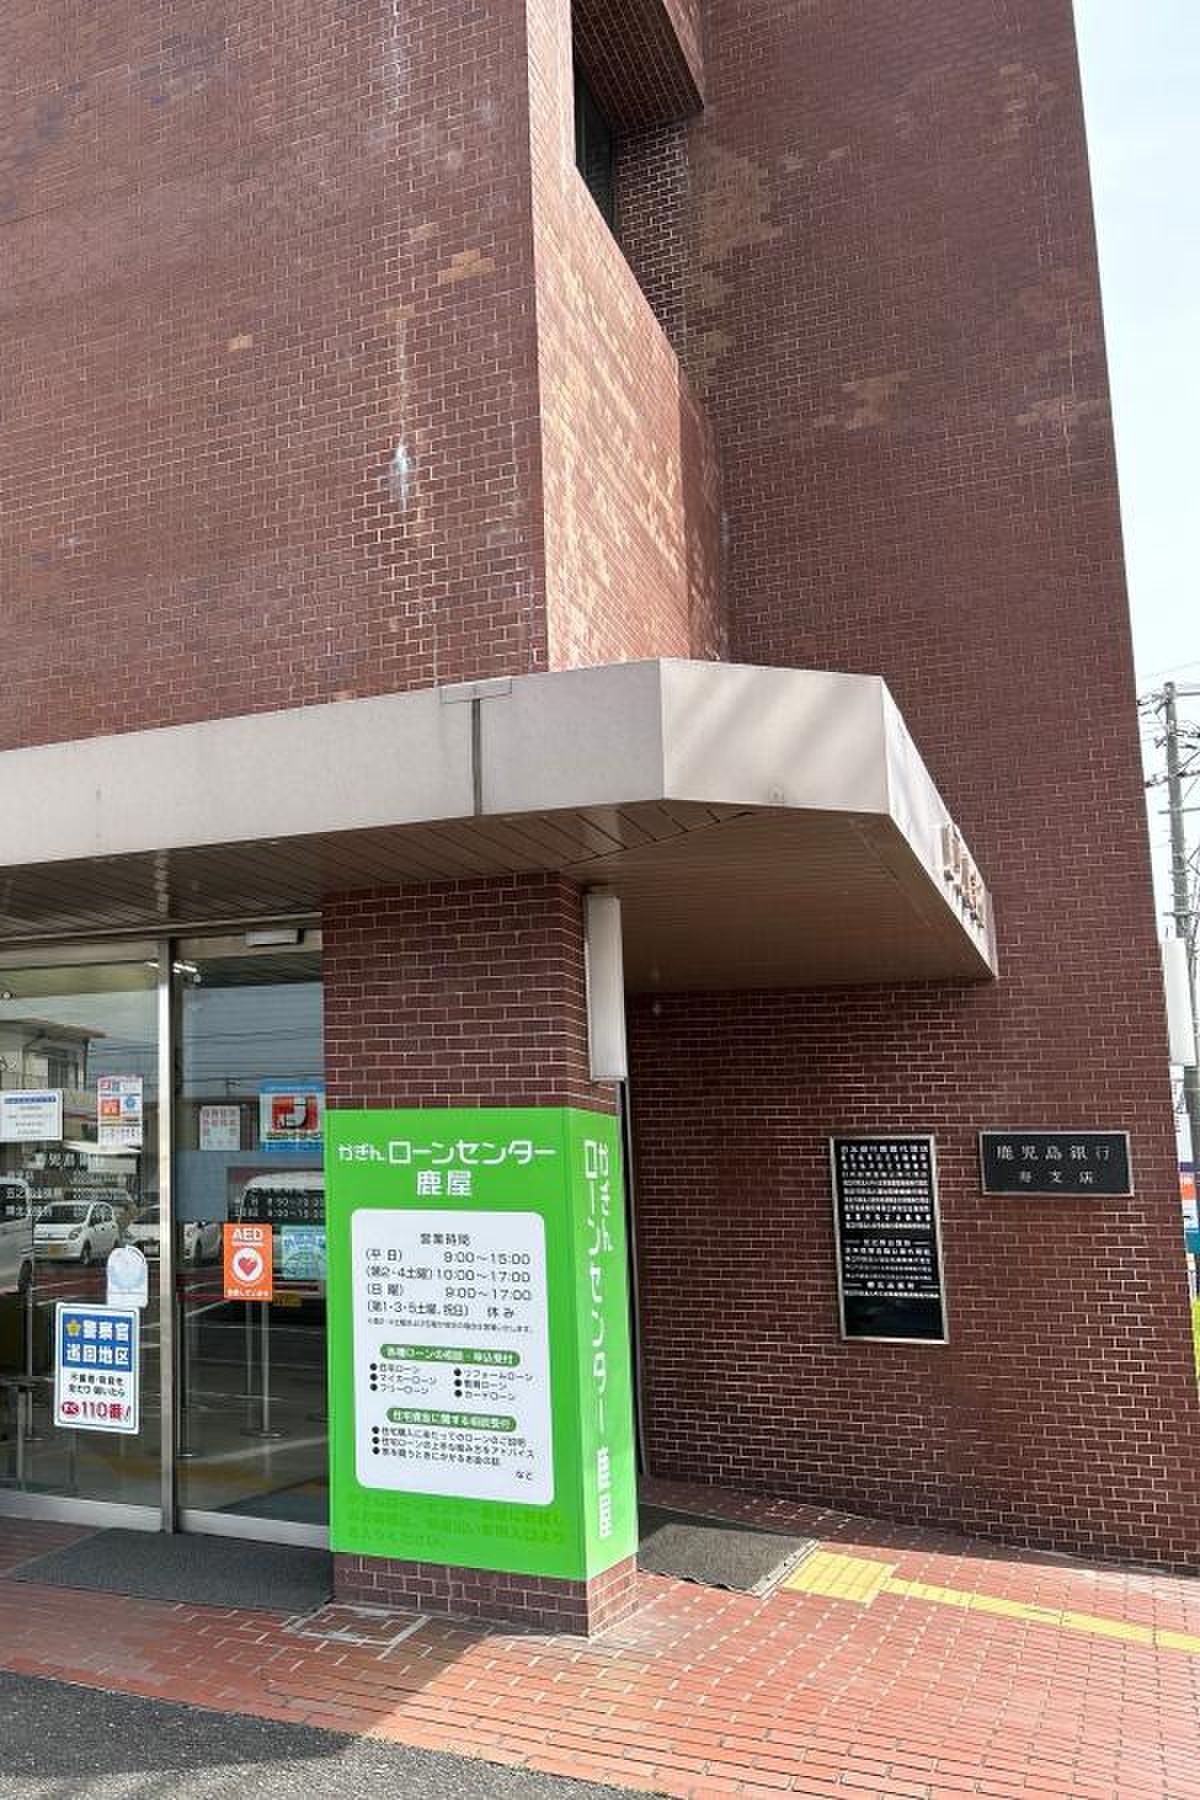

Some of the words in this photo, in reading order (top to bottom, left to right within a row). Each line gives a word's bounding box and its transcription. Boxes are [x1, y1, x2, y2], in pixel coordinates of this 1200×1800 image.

[996, 1144, 1110, 1161] 鹿児島銀行
[416, 1170, 472, 1196] 鹿屋
[232, 1228, 264, 1240] AED
[420, 1233, 471, 1246] 営業時間
[83, 1320, 129, 1341] 警察官
[66, 1343, 129, 1365] 巡回地区
